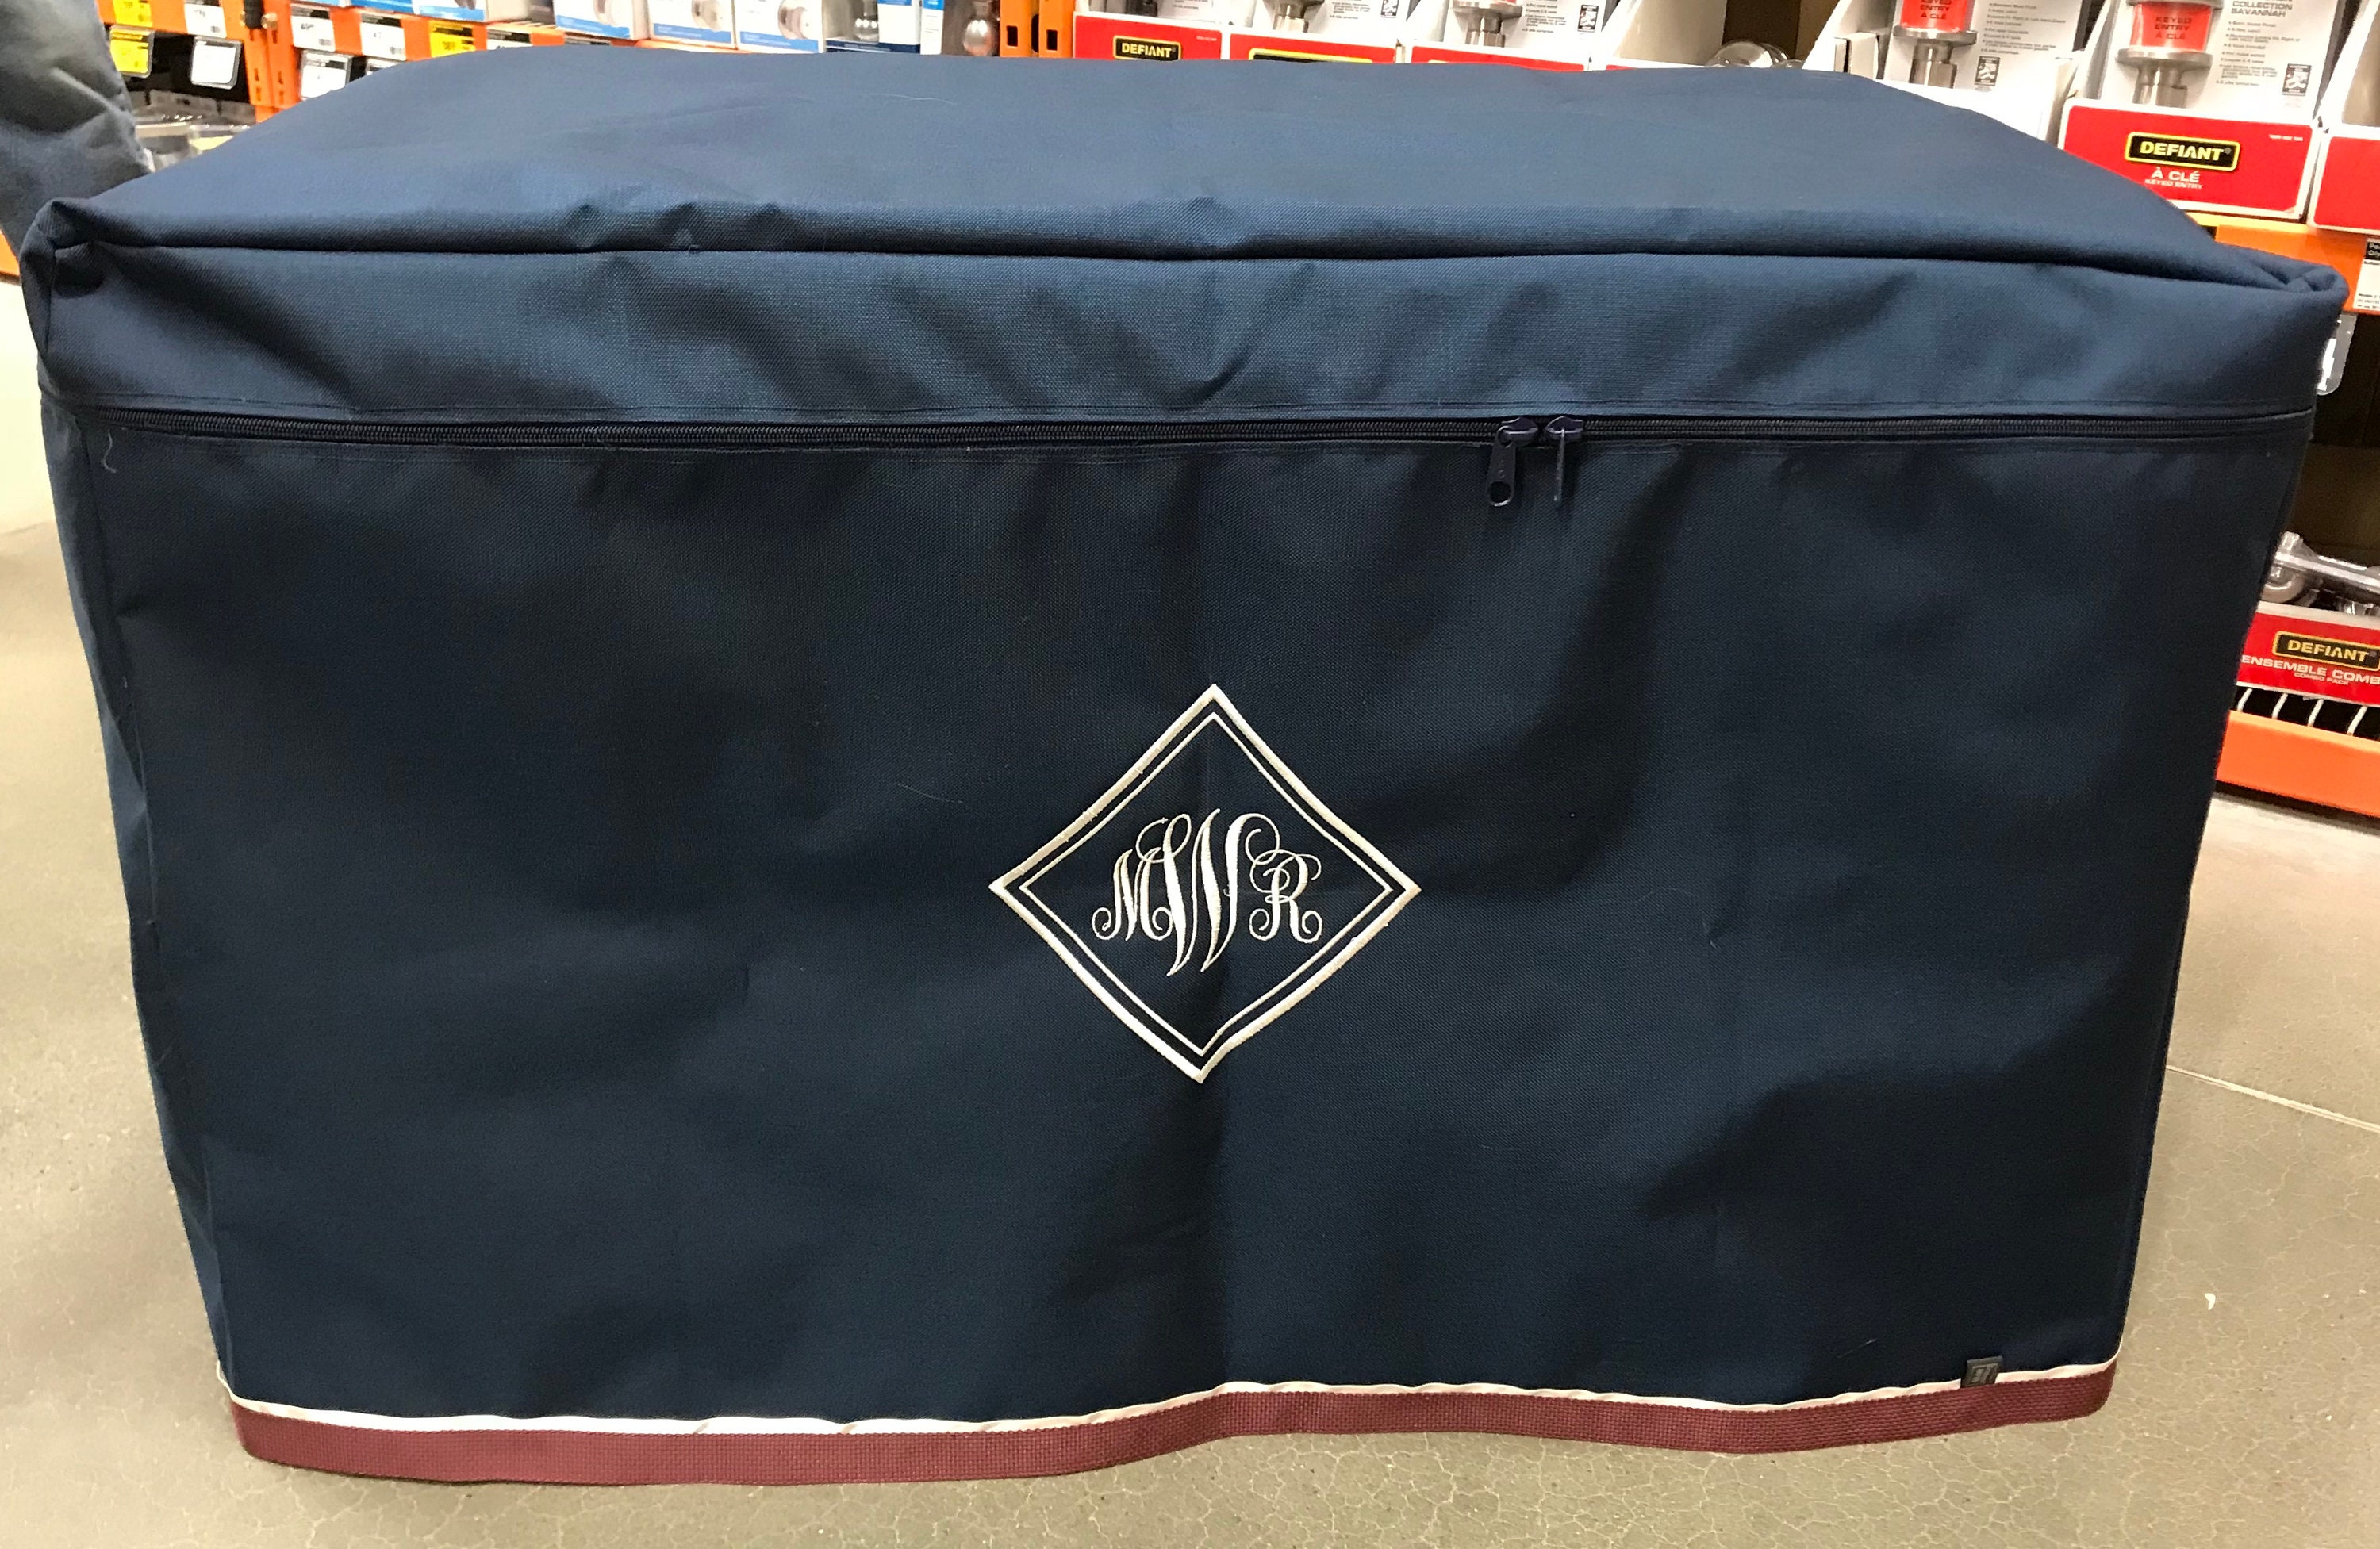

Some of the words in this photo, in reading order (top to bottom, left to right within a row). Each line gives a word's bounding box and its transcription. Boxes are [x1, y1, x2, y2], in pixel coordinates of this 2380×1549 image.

[2231, 8, 2286, 17] SAVANNAH
[2232, 1, 2293, 10] COLLECTION
[1122, 42, 1172, 58] DEFIANT
[2140, 140, 2225, 161] DEFIANT
[2151, 166, 2163, 179] À
[2168, 170, 2201, 183] CLÉ
[2175, 180, 2203, 190] ENTRY
[2287, 639, 2370, 662] DEFIANT
[2240, 654, 2328, 677] ENSEMBLE
[2294, 671, 2325, 681] COMBO
[2326, 676, 2350, 686] PACK
